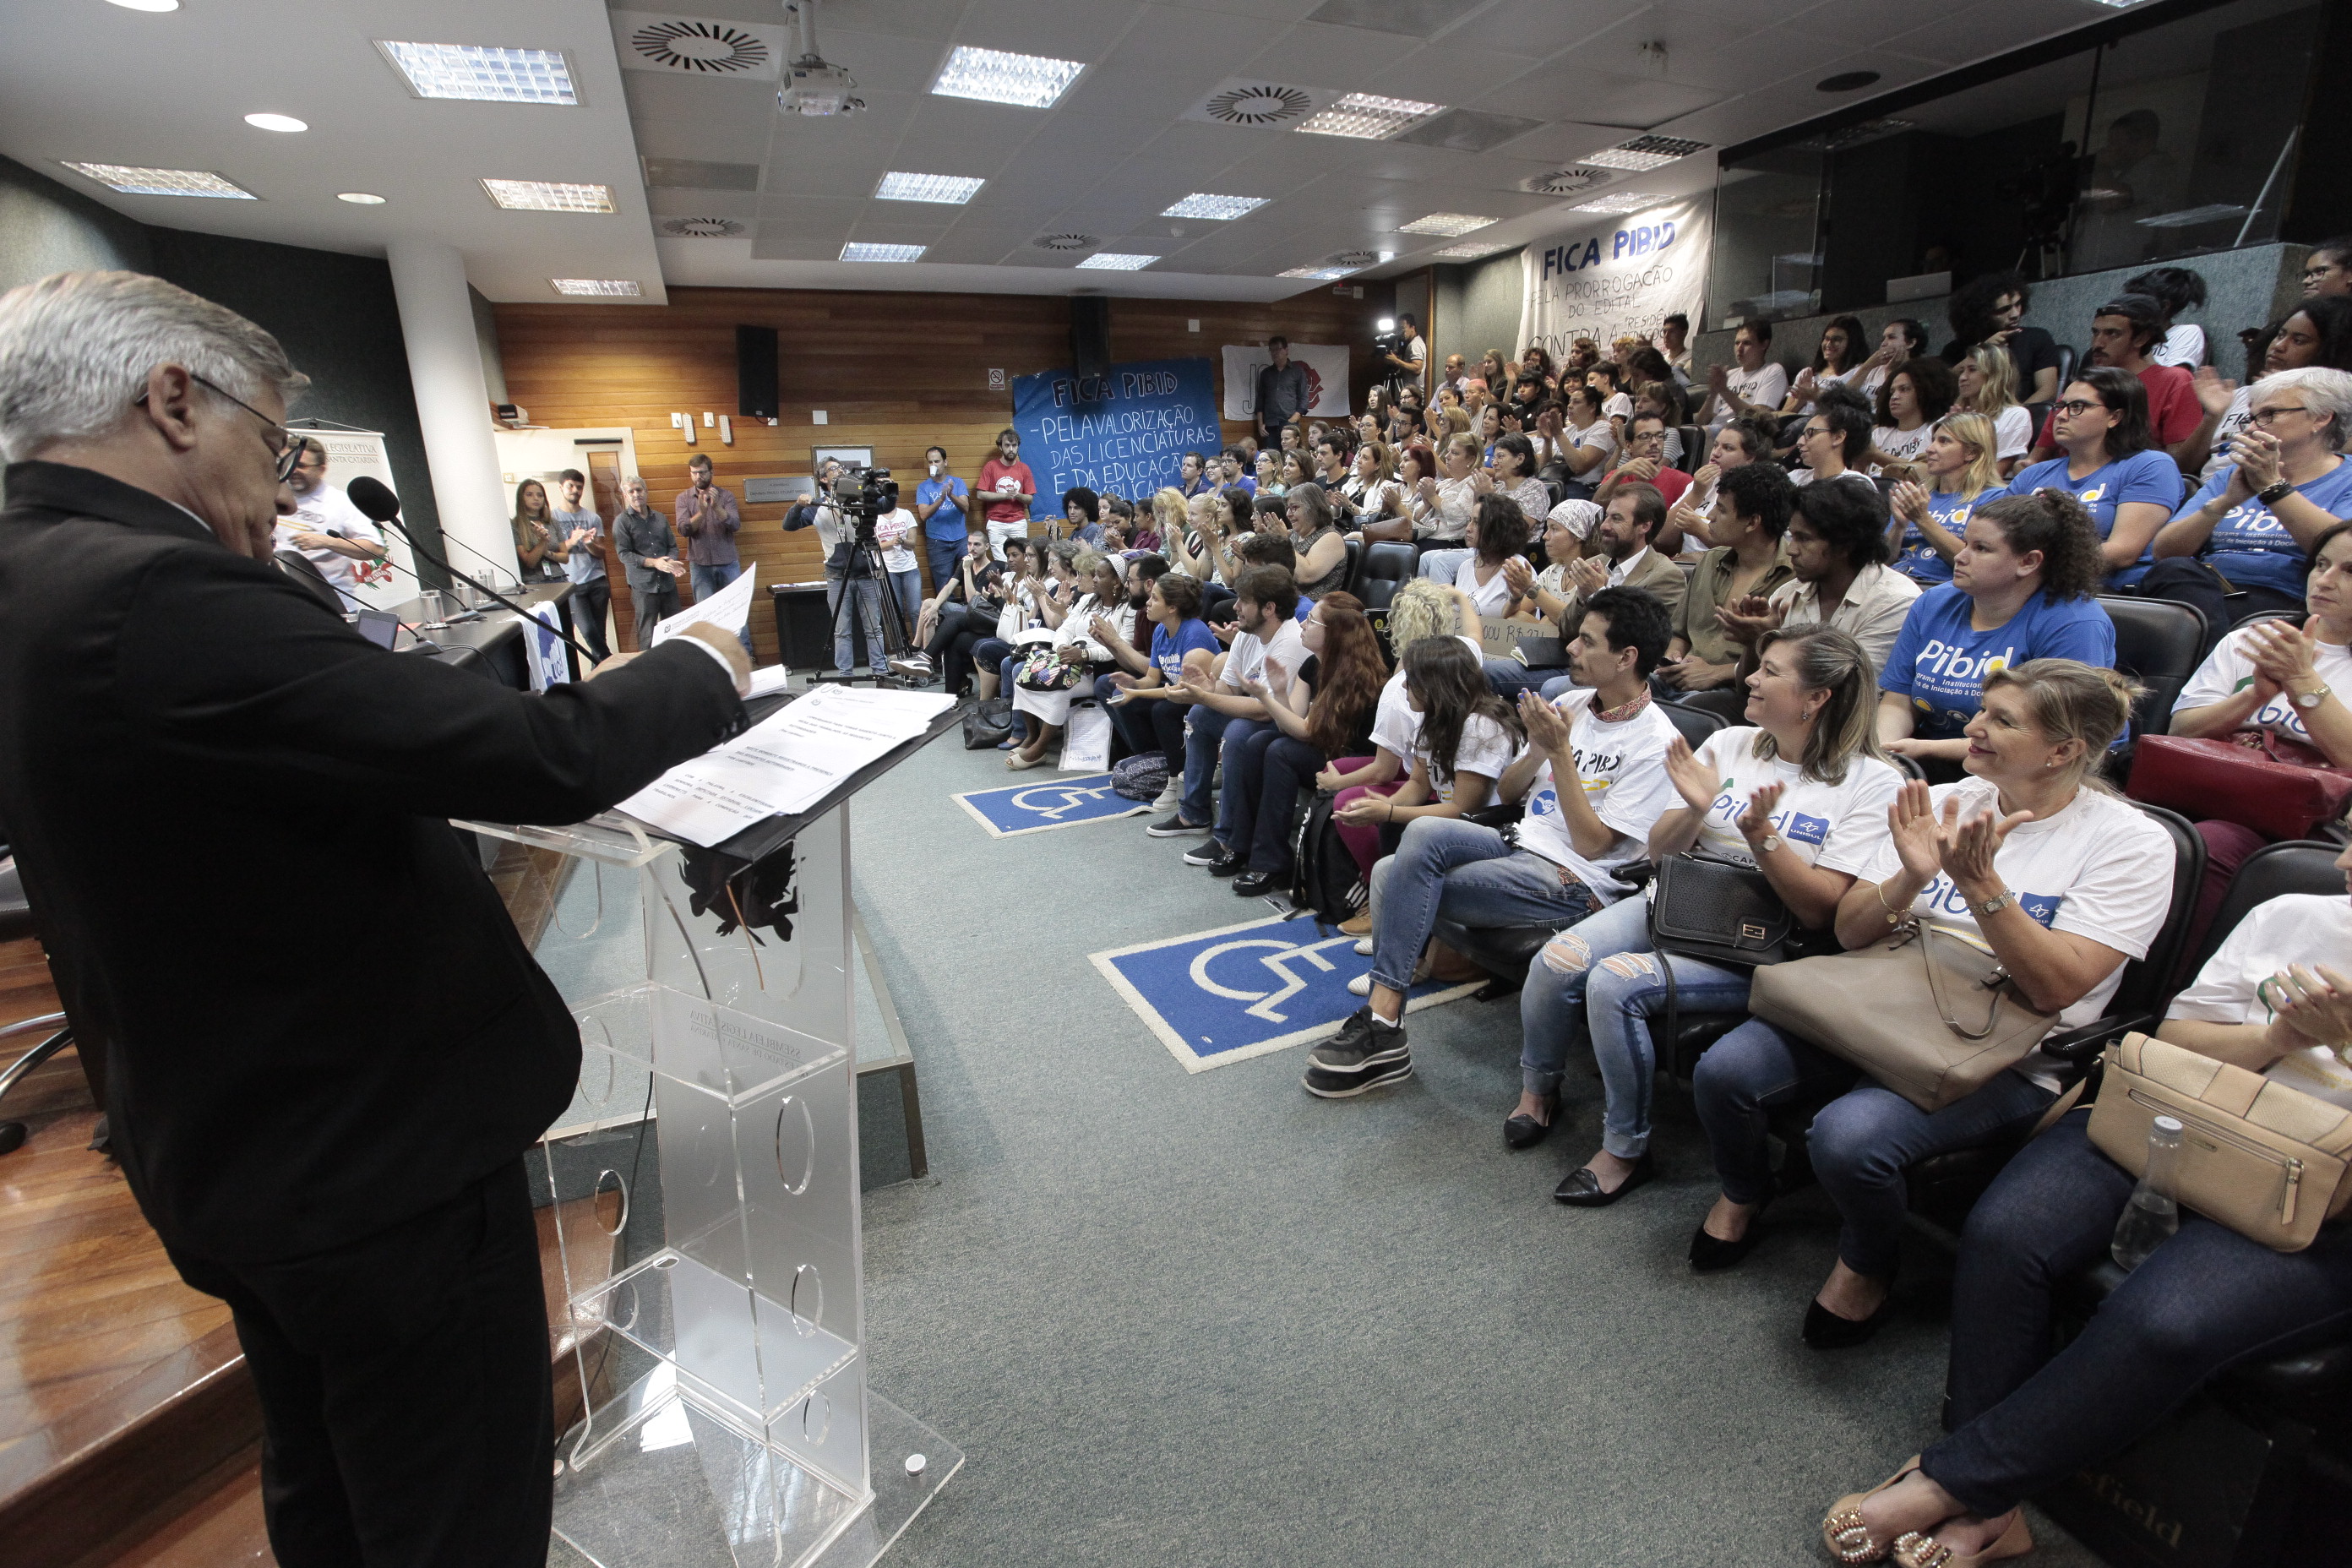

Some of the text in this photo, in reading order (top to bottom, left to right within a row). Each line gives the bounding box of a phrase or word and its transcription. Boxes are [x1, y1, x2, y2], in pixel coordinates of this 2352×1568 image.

[1544, 222, 1675, 280] FICA PIBID
[1569, 294, 1641, 318] DO EDITAL
[1608, 324, 1618, 347] A
[1052, 372, 1178, 407] FICA PIBID
[325, 443, 378, 454] LEGISLATIVA
[1051, 425, 1216, 470] DAS LICENCIATURAS
[346, 455, 379, 465] CATARINA
[1054, 452, 1186, 495] E DA EDUCAÇÃ
[1916, 640, 2014, 678] Pibid
[1916, 672, 1983, 689] grama Institucion
[1931, 685, 1963, 695] Iniciação
[1789, 828, 1822, 841] UNISUL
